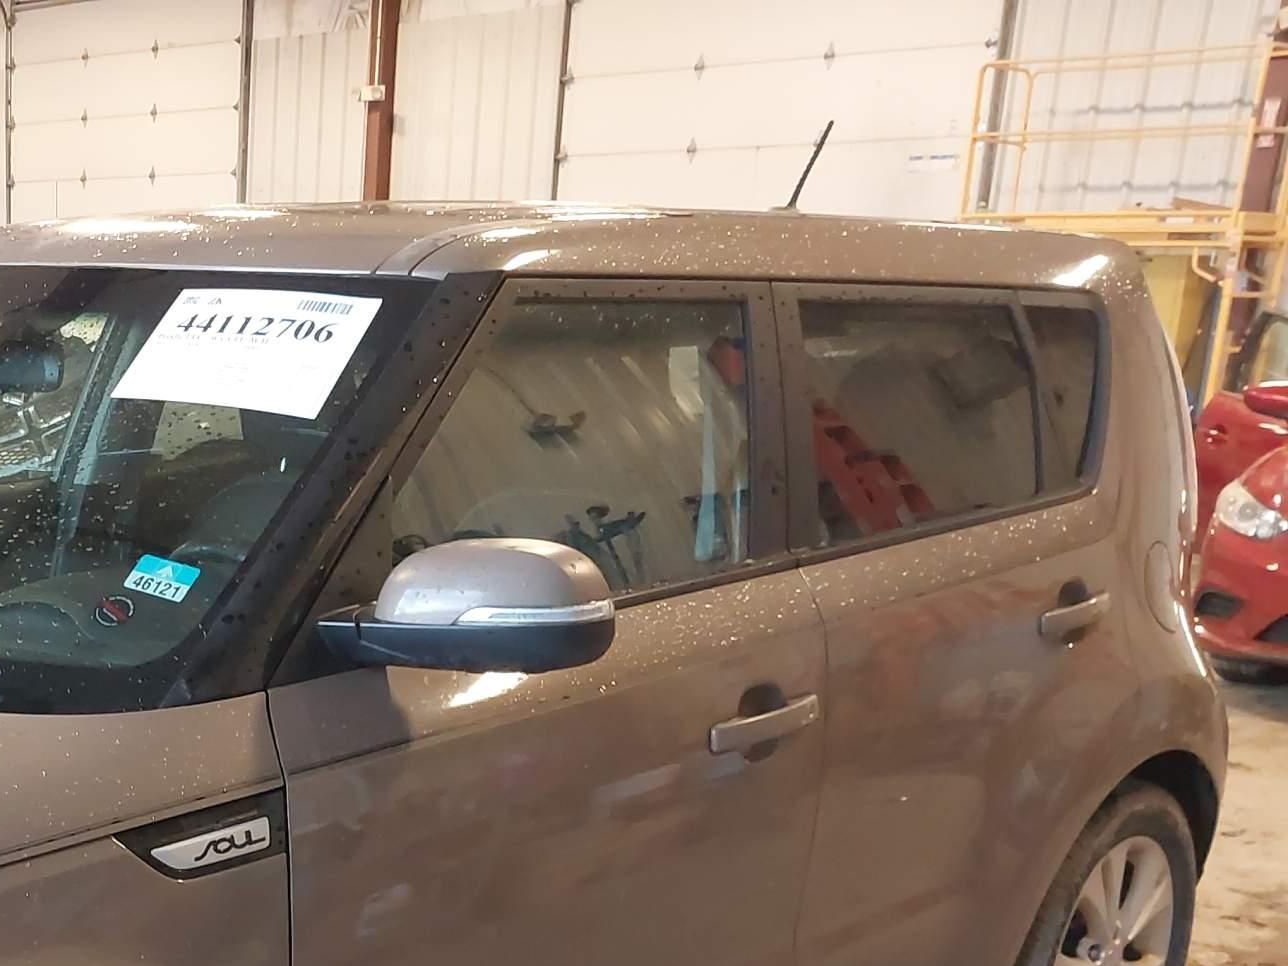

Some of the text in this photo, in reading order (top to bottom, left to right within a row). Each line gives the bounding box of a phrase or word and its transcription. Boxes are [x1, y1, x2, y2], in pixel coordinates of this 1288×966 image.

[175, 312, 340, 343] 44112706
[133, 575, 181, 599] 46121
[194, 829, 266, 862] SOUL
